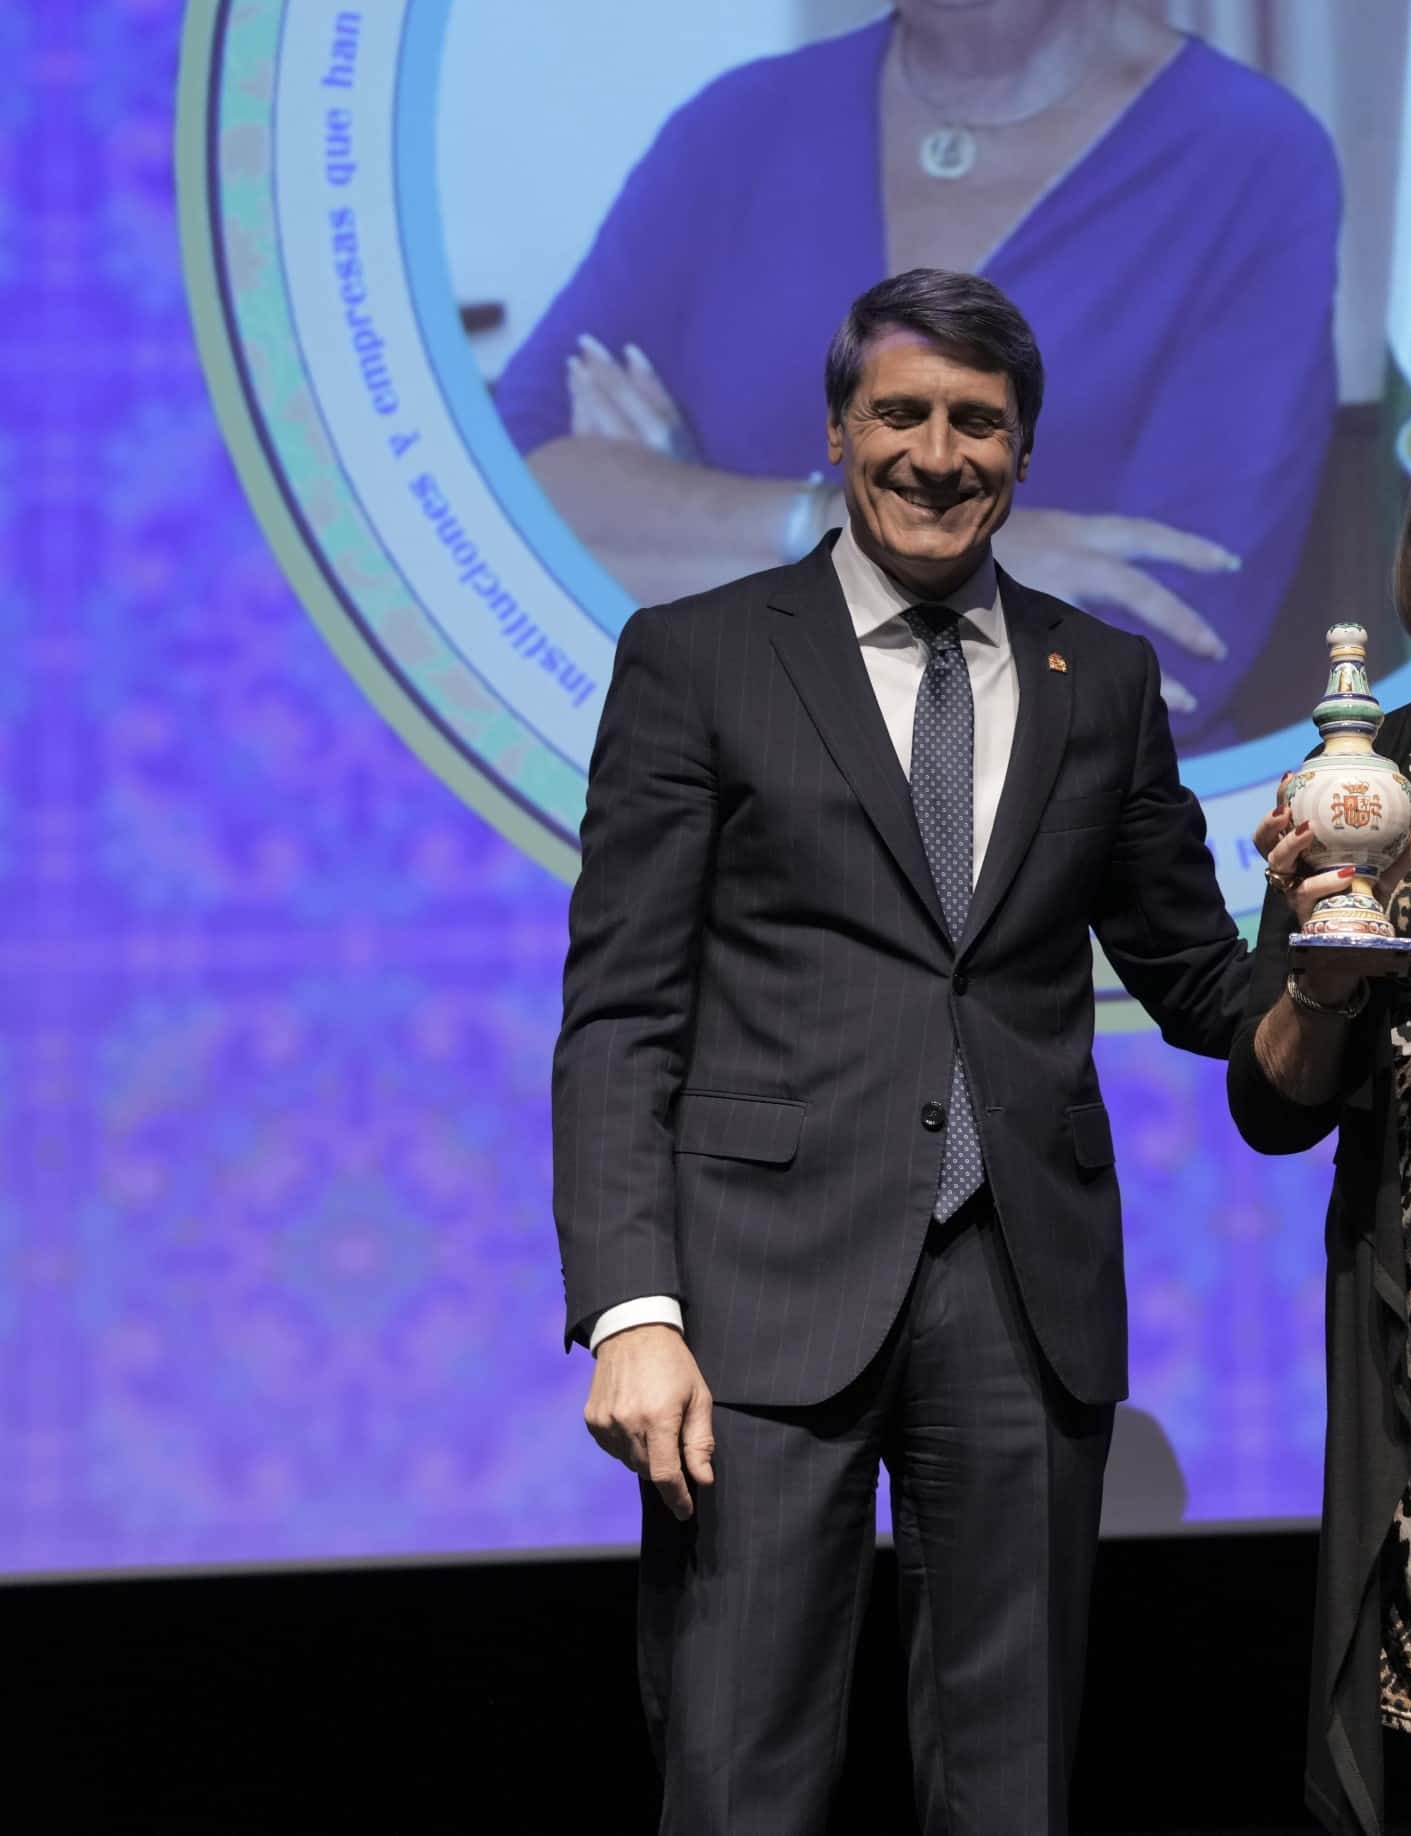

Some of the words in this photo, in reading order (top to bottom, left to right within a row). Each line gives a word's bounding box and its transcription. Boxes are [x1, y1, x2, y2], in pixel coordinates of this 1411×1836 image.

[319, 10, 362, 88] han
[324, 107, 358, 188] que
[328, 206, 400, 417] empresas
[408, 473, 598, 709] Instituciones
